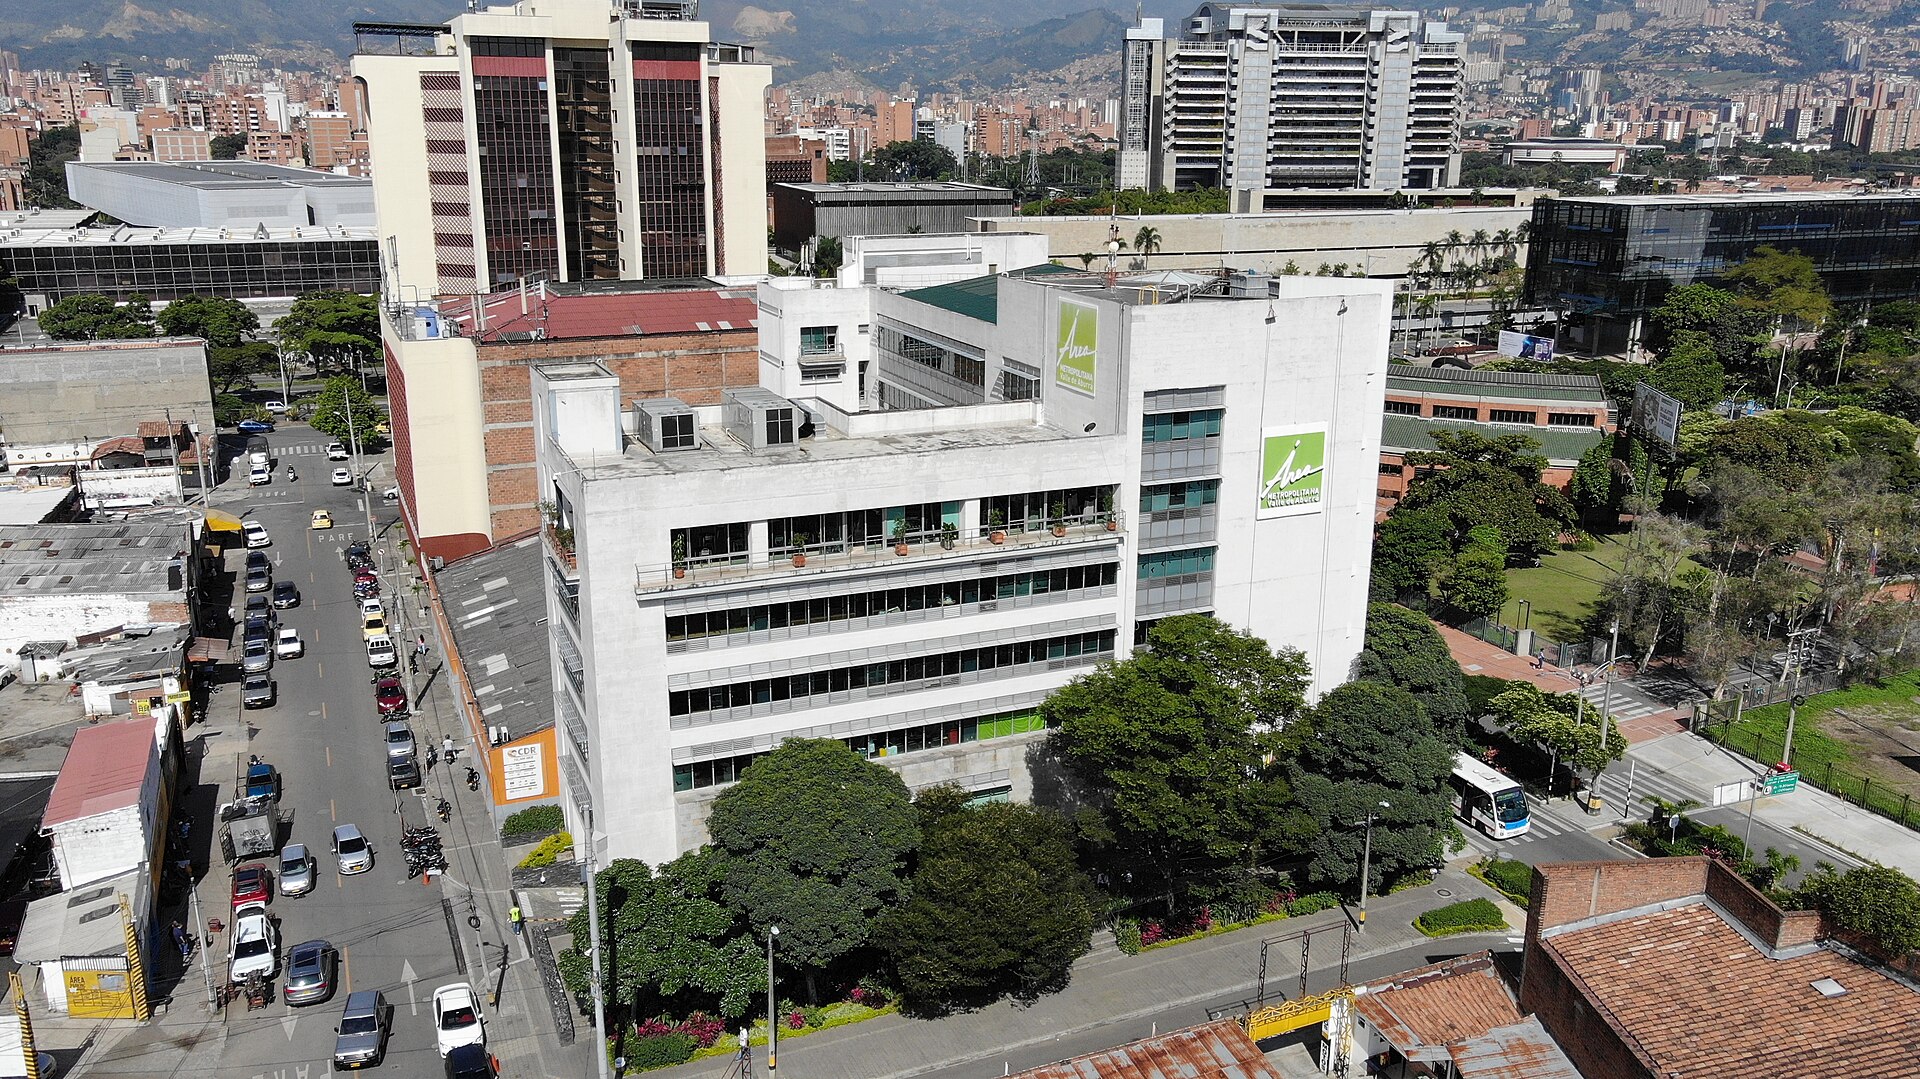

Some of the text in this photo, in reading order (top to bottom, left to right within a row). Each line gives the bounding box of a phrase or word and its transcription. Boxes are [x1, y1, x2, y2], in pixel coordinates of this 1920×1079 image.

[1060, 365, 1093, 380] METROPOLITANA
[1060, 372, 1071, 383] Valle
[1267, 488, 1320, 500] METROPOLITANA
[1285, 498, 1294, 506] de
[318, 533, 354, 543] PARE
[518, 747, 536, 755] CDR
